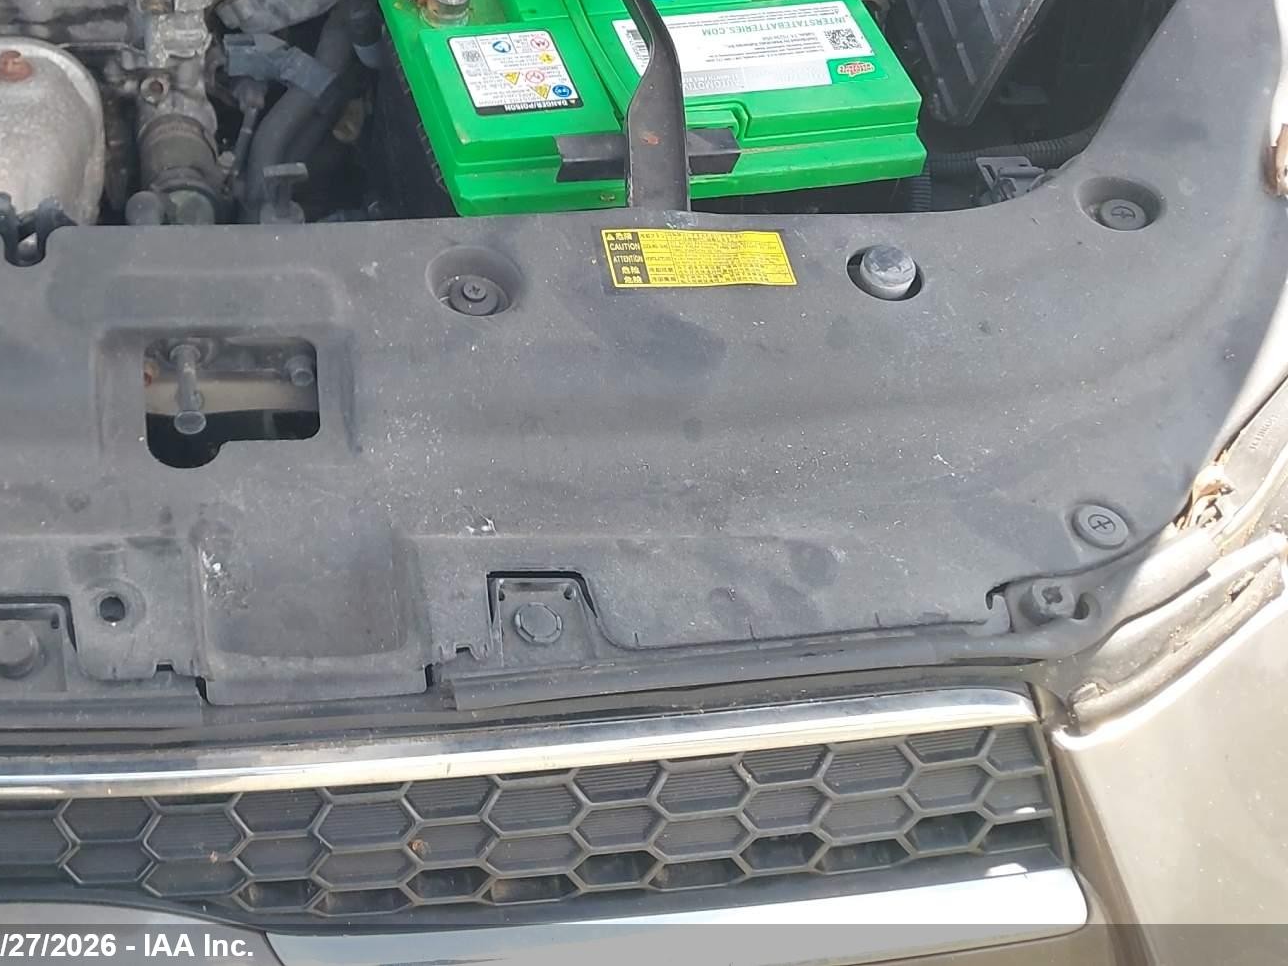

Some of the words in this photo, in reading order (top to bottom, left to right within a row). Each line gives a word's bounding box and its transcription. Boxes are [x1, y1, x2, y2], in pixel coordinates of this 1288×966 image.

[702, 17, 846, 36] INTERSTATEBATTERIES.COM
[682, 77, 743, 91] AUTOMOTIV
[504, 99, 569, 111] DANGER/POISON
[609, 242, 640, 251] CAUTION
[613, 255, 643, 263] ATTENTION
